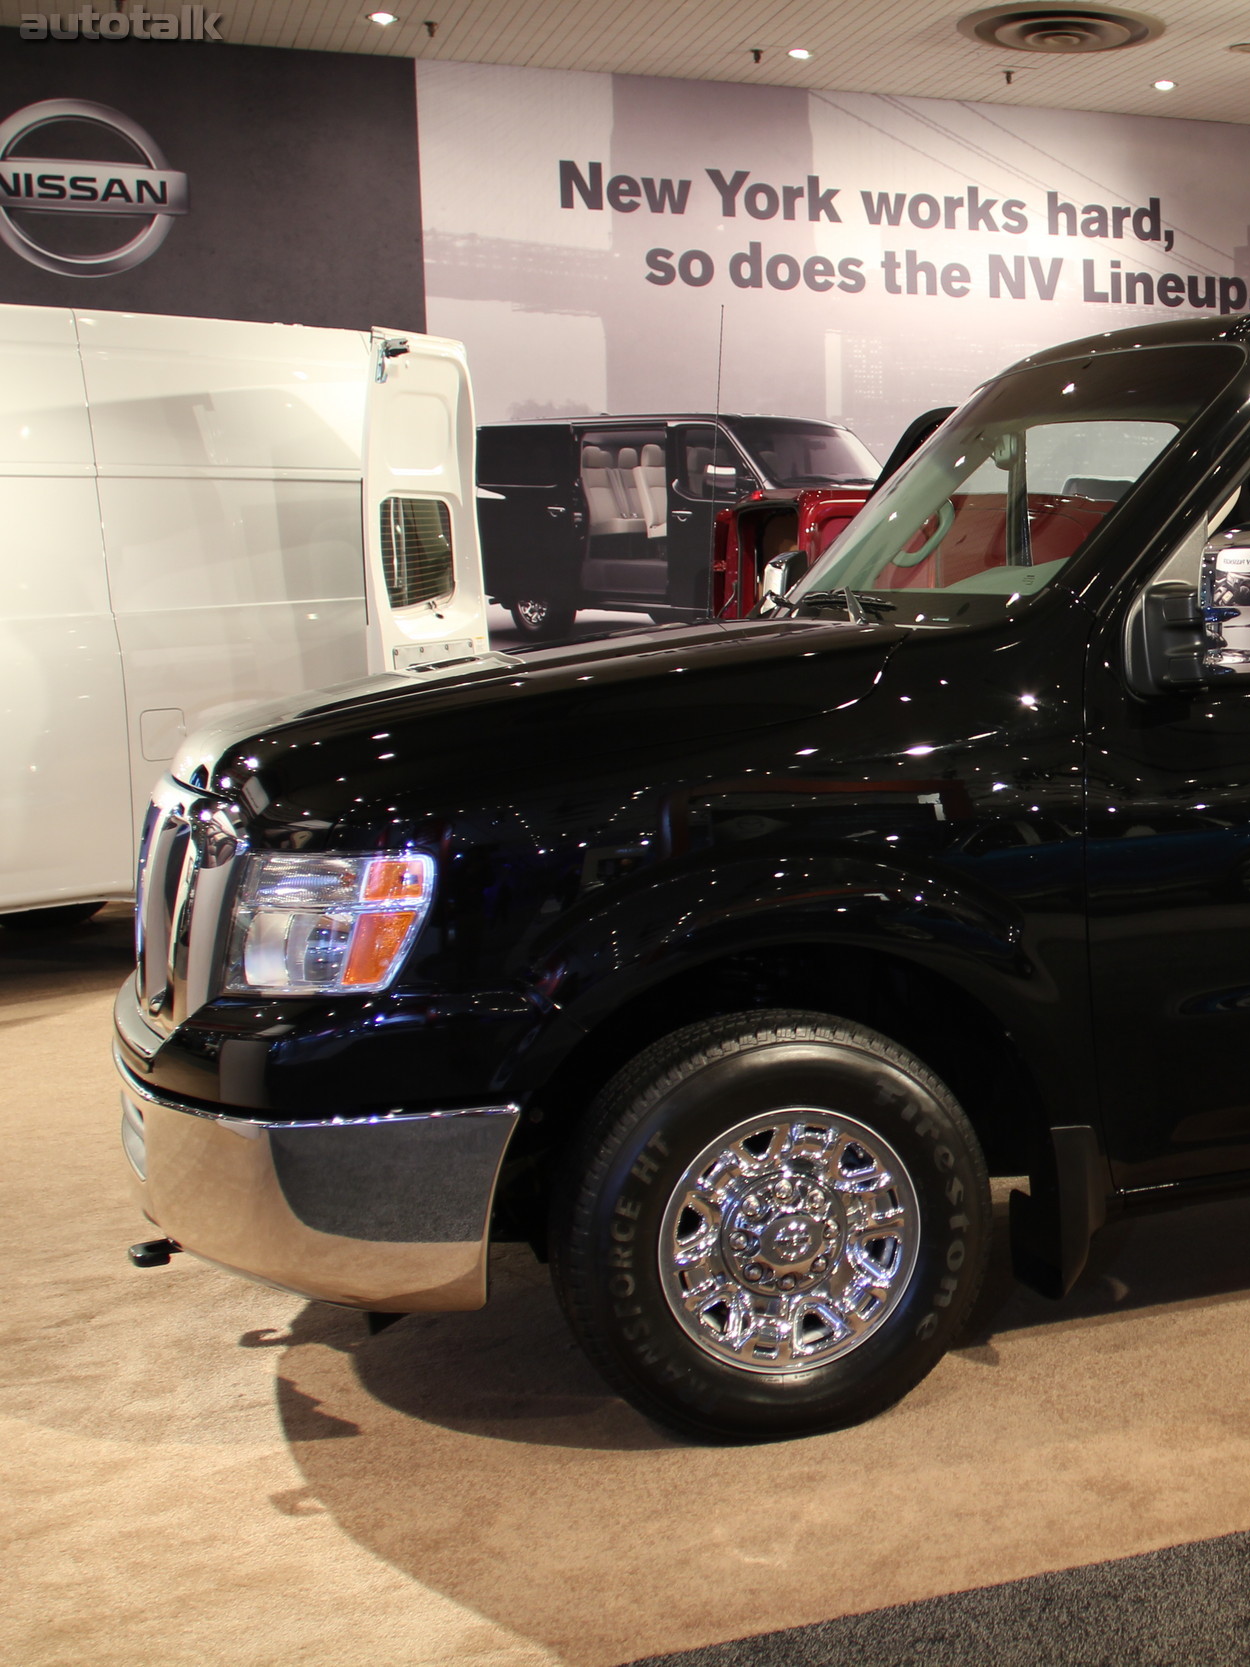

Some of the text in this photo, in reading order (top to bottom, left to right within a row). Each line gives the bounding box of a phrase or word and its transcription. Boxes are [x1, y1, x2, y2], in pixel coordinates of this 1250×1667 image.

[0, 172, 168, 205] NISSAN
[559, 160, 1174, 252] New York works hard,
[645, 248, 715, 288] so
[729, 241, 866, 293] does
[881, 249, 971, 298] the
[989, 254, 1064, 301] NV
[629, 1130, 671, 1186] HT
